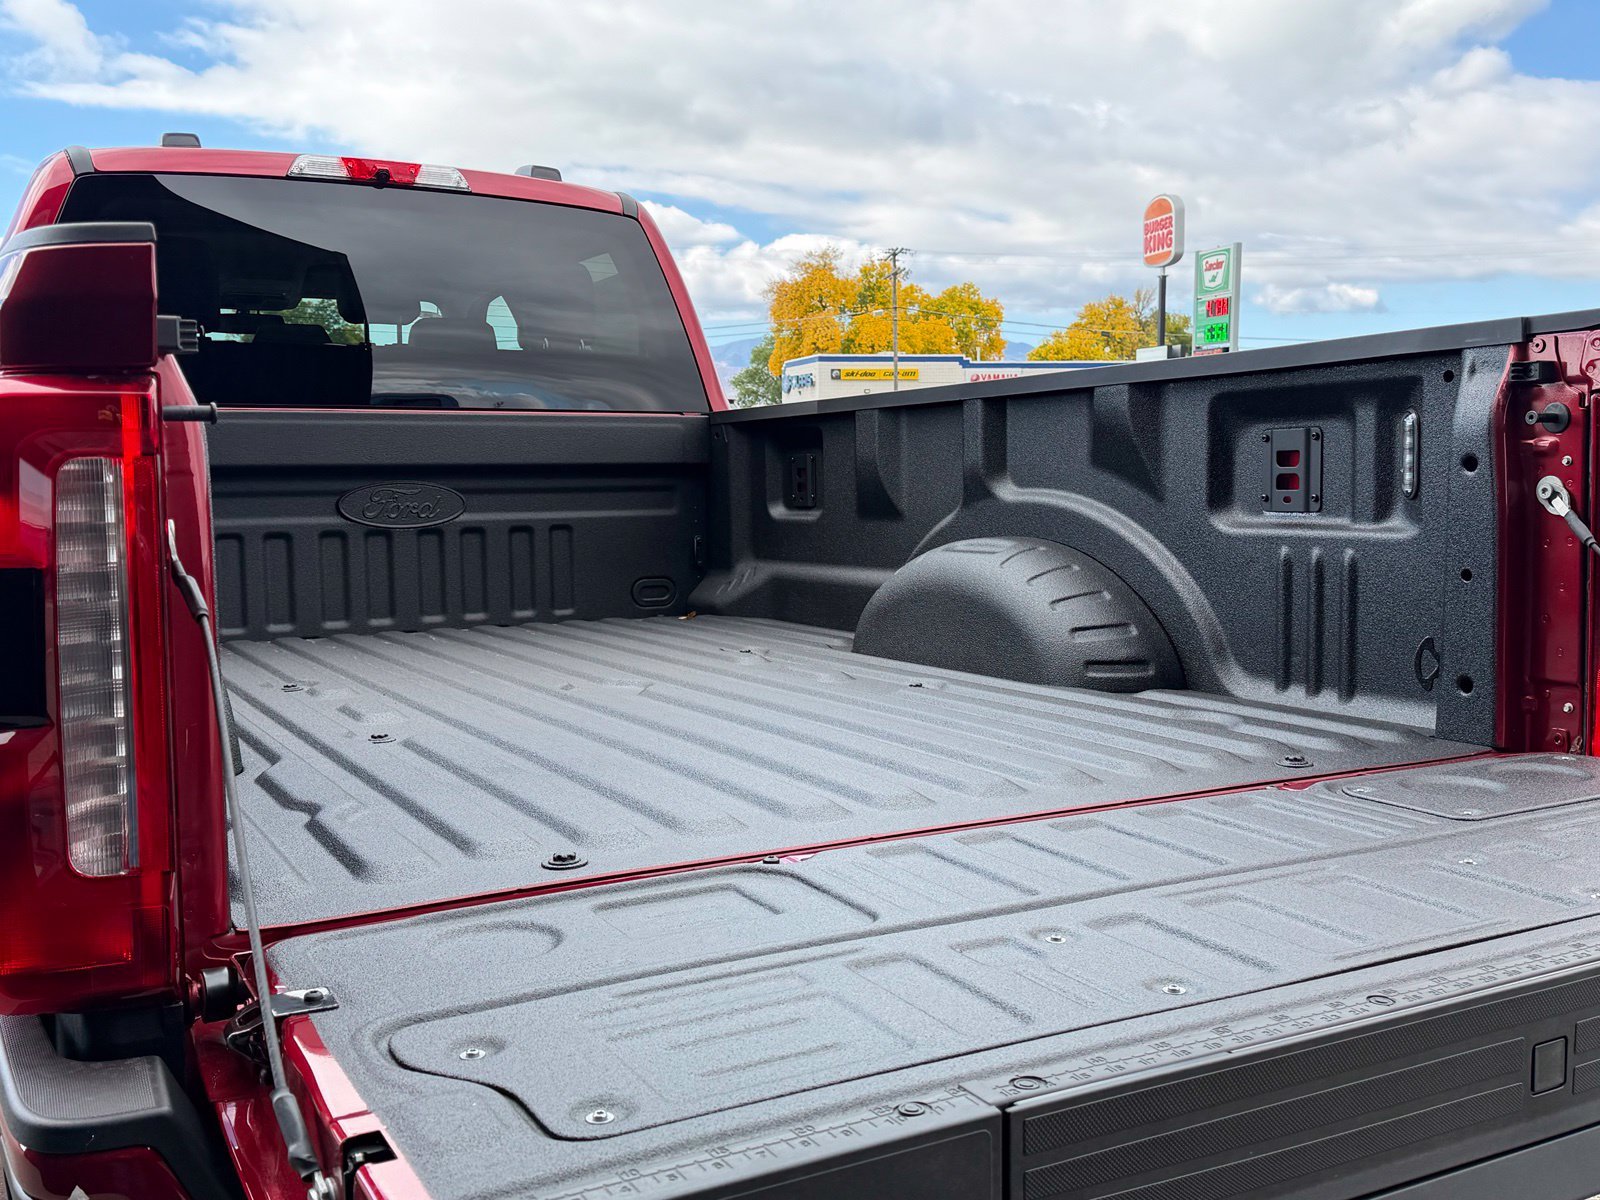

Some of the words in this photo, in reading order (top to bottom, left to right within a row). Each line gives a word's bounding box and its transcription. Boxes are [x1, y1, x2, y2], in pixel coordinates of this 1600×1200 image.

[1144, 215, 1173, 236] BURGER
[1144, 229, 1173, 255] KING
[845, 370, 876, 378] ski-doo
[362, 487, 441, 519] Ford
[620, 1168, 640, 1178] 10
[711, 1146, 730, 1155] 15
[794, 1124, 815, 1134] 20
